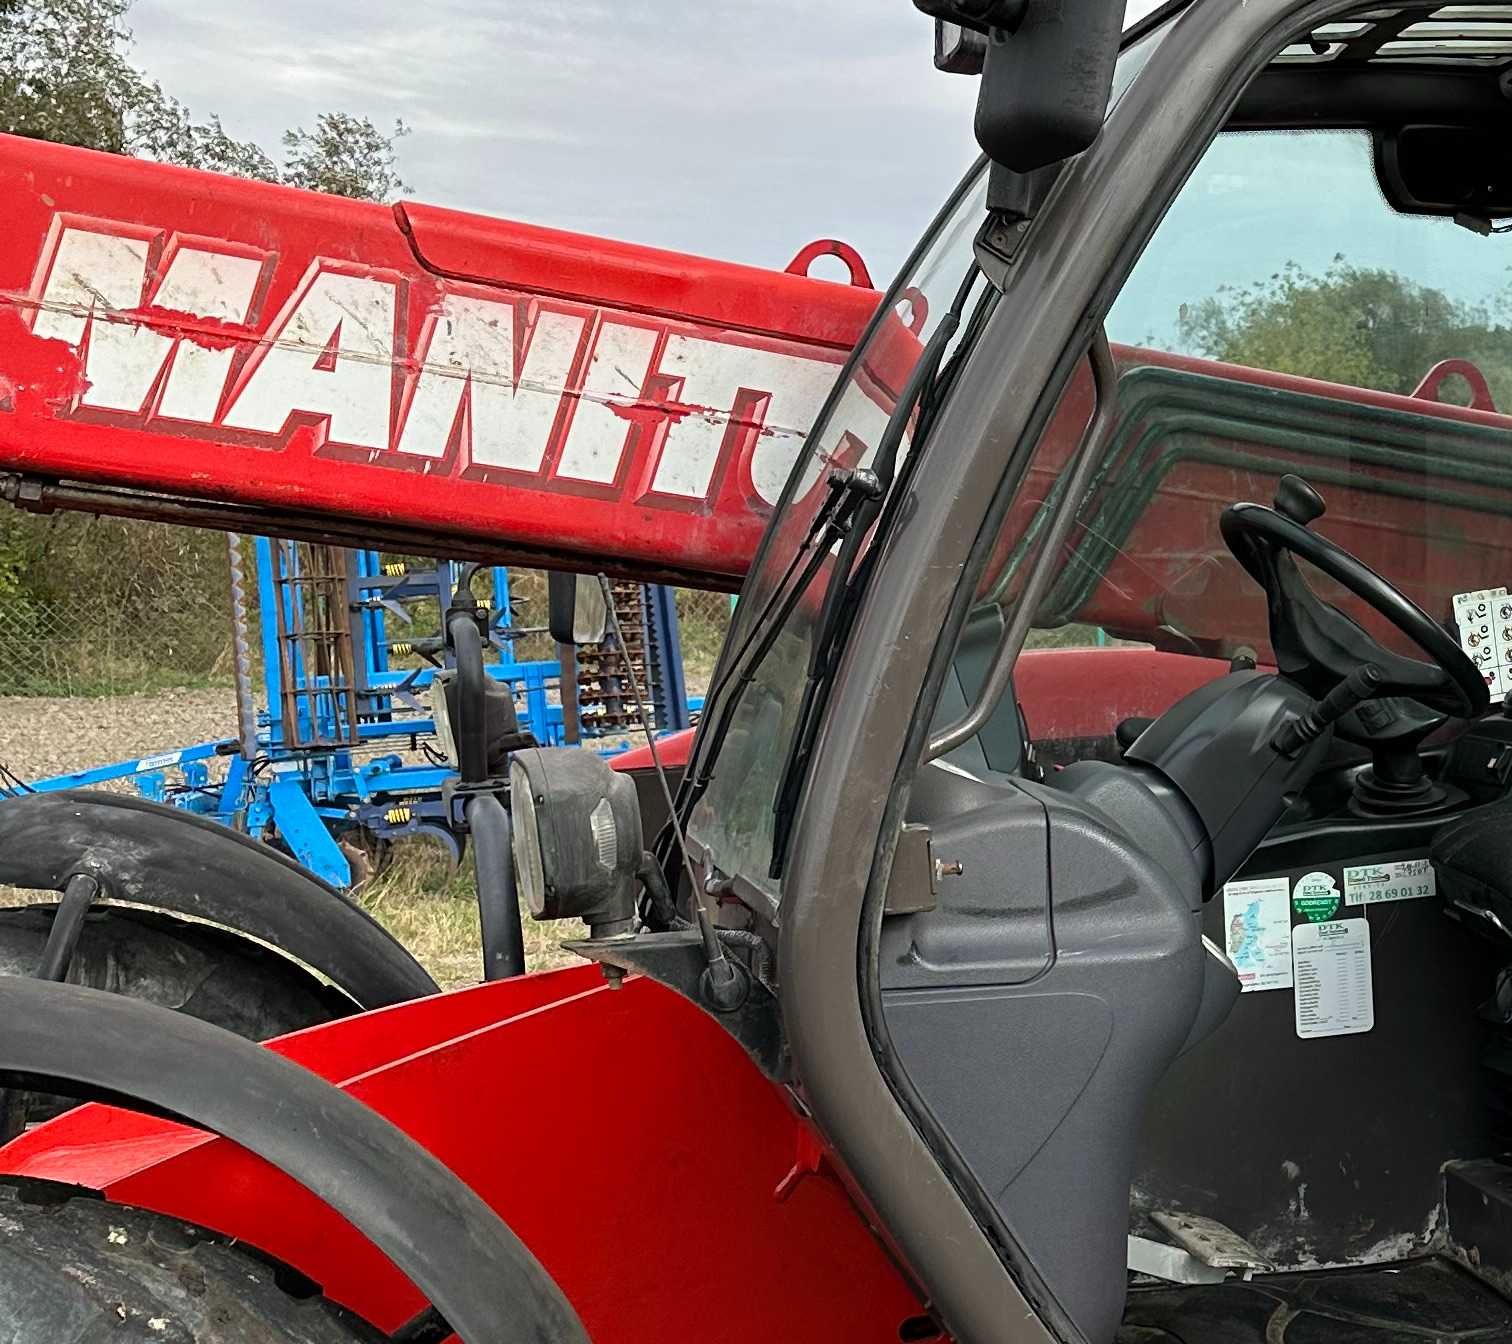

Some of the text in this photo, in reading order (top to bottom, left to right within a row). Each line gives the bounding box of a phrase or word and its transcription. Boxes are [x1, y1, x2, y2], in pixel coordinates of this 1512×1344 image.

[26, 214, 908, 536] MANITO
[1346, 866, 1384, 880] DTK
[1369, 890, 1382, 900] 28
[1385, 888, 1398, 899] 69
[1400, 887, 1413, 897] 01
[1416, 885, 1430, 896] 32
